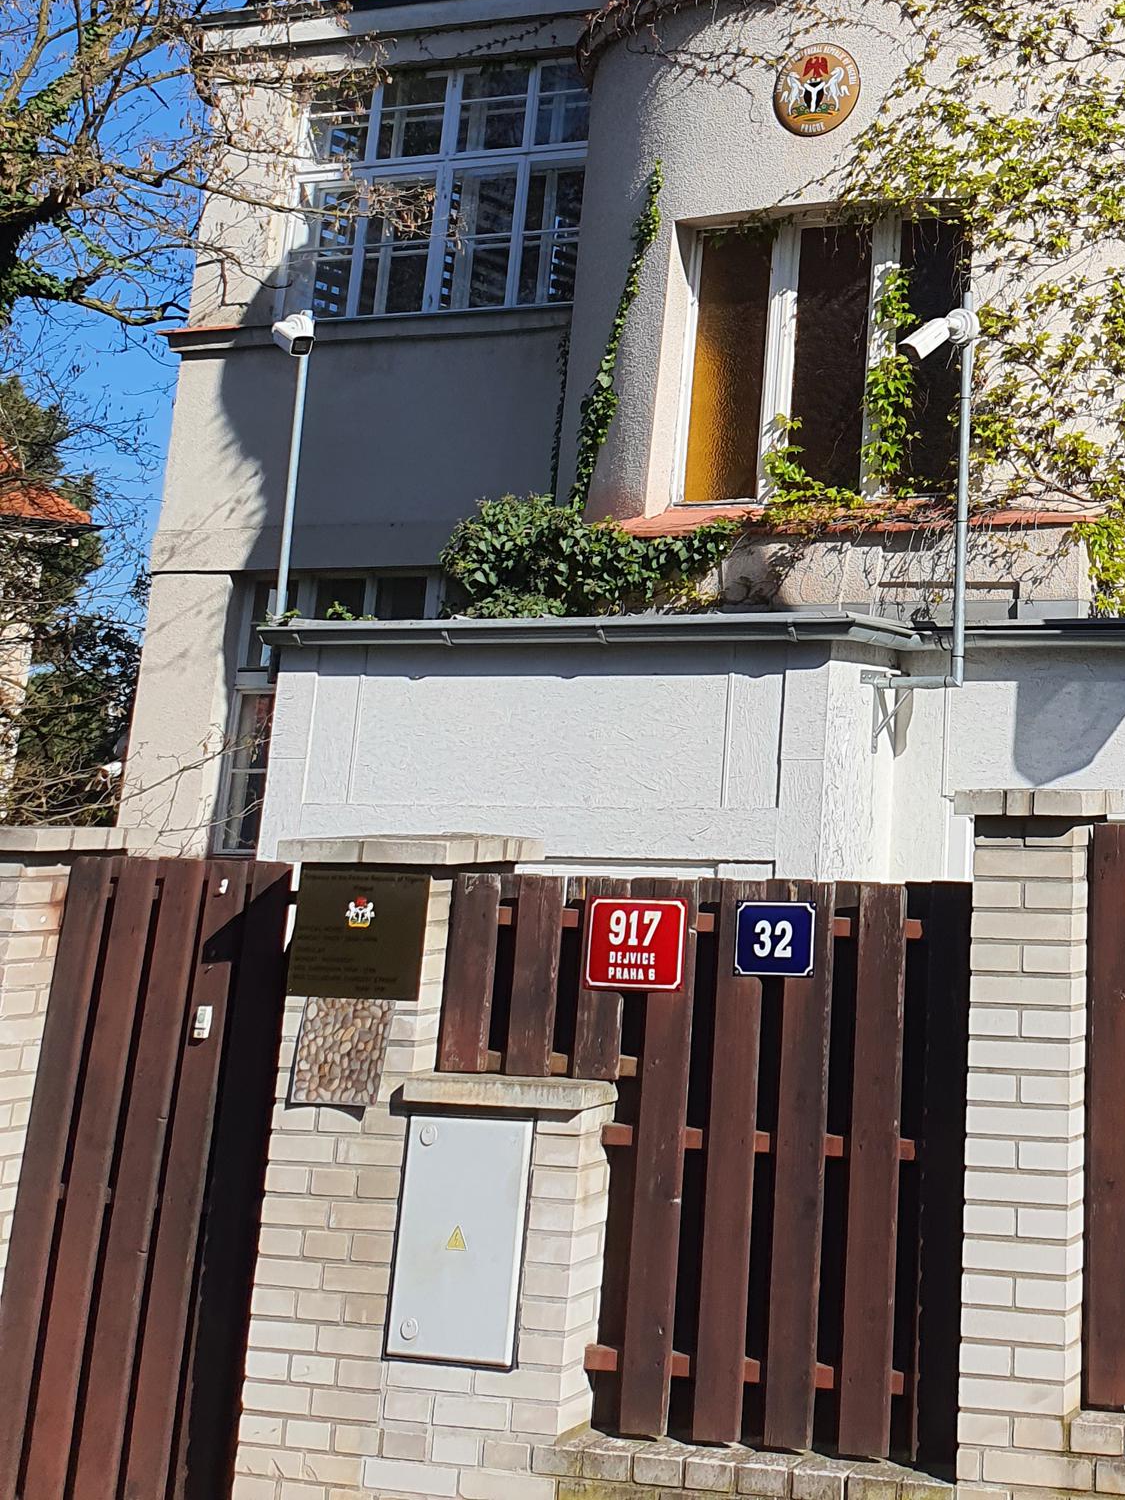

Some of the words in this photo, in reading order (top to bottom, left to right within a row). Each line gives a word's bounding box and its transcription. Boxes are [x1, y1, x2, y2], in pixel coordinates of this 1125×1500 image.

[800, 122, 826, 133] PRAGUE
[608, 909, 662, 947] 917
[753, 919, 793, 958] 32
[609, 951, 656, 965] DEJVICE
[608, 966, 645, 980] PRAHA
[648, 968, 656, 981] 6
